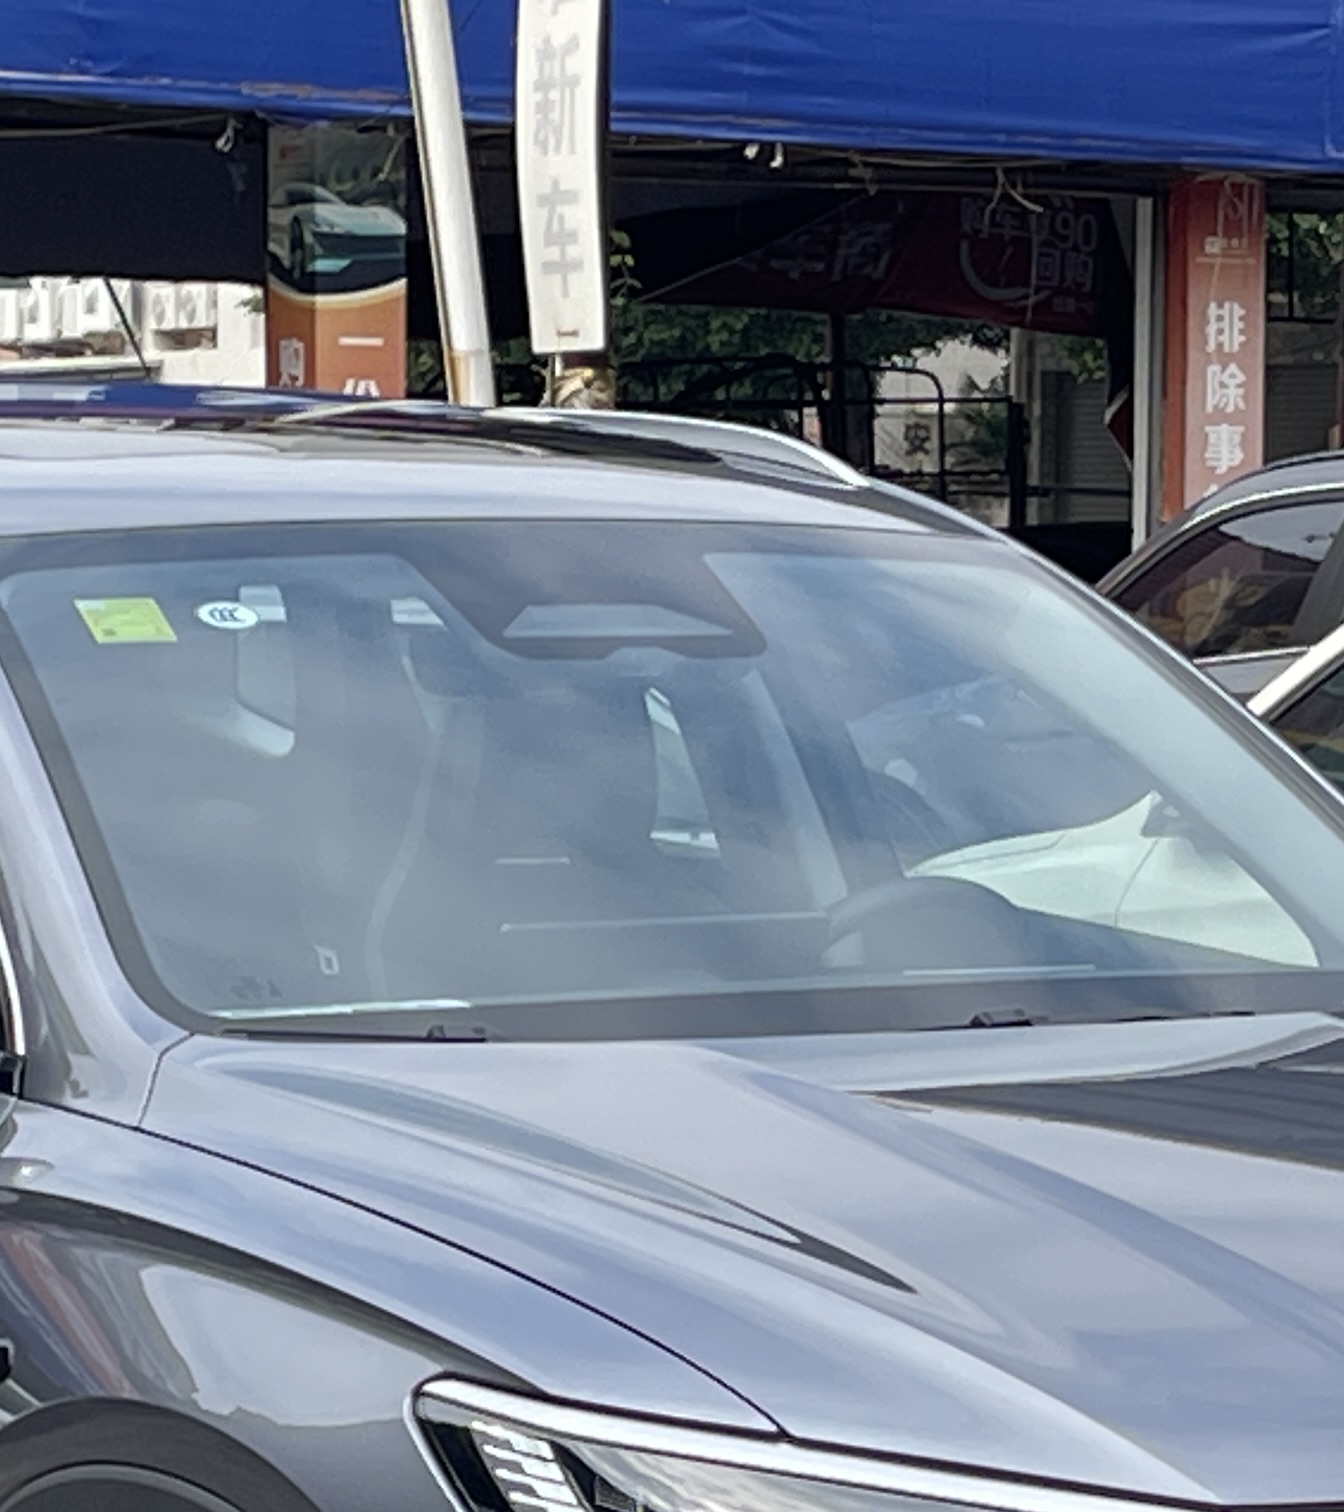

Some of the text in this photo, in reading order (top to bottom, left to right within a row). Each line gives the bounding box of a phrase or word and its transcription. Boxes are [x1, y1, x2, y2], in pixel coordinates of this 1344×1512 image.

[532, 0, 584, 299] 新车
[1203, 302, 1248, 497] 排除事
